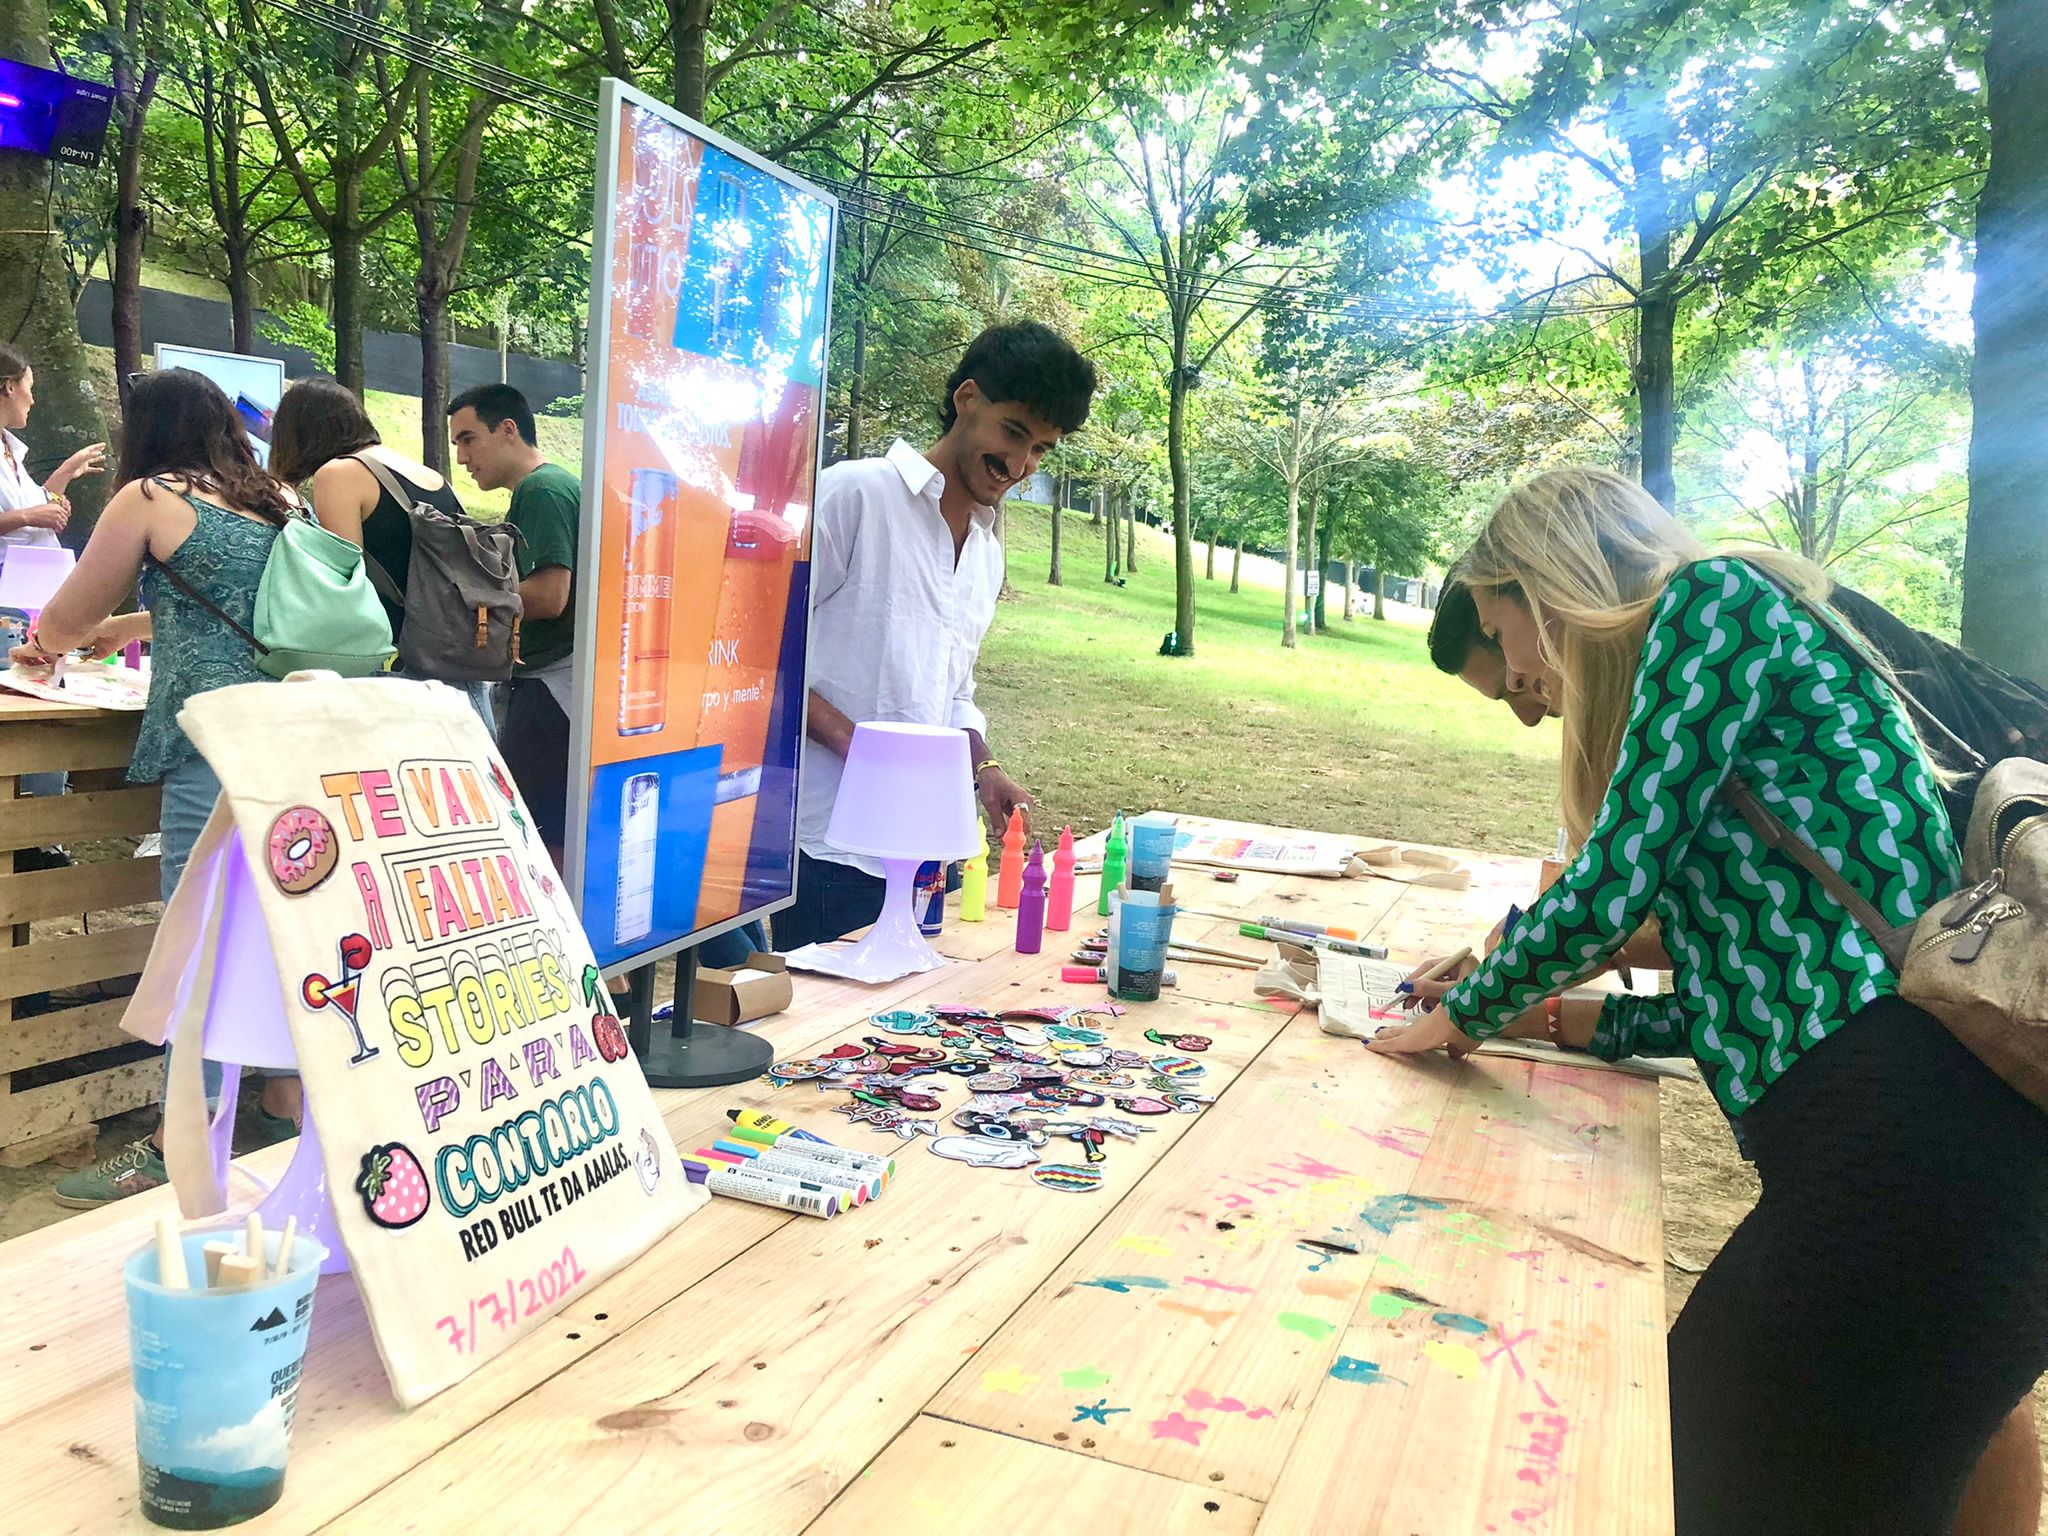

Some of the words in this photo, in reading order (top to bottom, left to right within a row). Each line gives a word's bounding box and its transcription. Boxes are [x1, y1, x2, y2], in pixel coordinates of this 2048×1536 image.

[60, 146, 94, 161] LN-400
[320, 769, 406, 841] TE
[406, 768, 492, 828] VAN
[351, 861, 392, 950] A
[403, 855, 533, 941] FALTAR
[386, 950, 572, 1068] STORIES
[435, 1076, 620, 1219] CONTARLO
[458, 1218, 499, 1262] RED
[498, 1195, 542, 1240] BULL
[540, 1182, 562, 1216] TE
[561, 1171, 585, 1207] DA
[584, 1142, 632, 1196] AAALAS.
[435, 1245, 587, 1355] 7/7/2022
